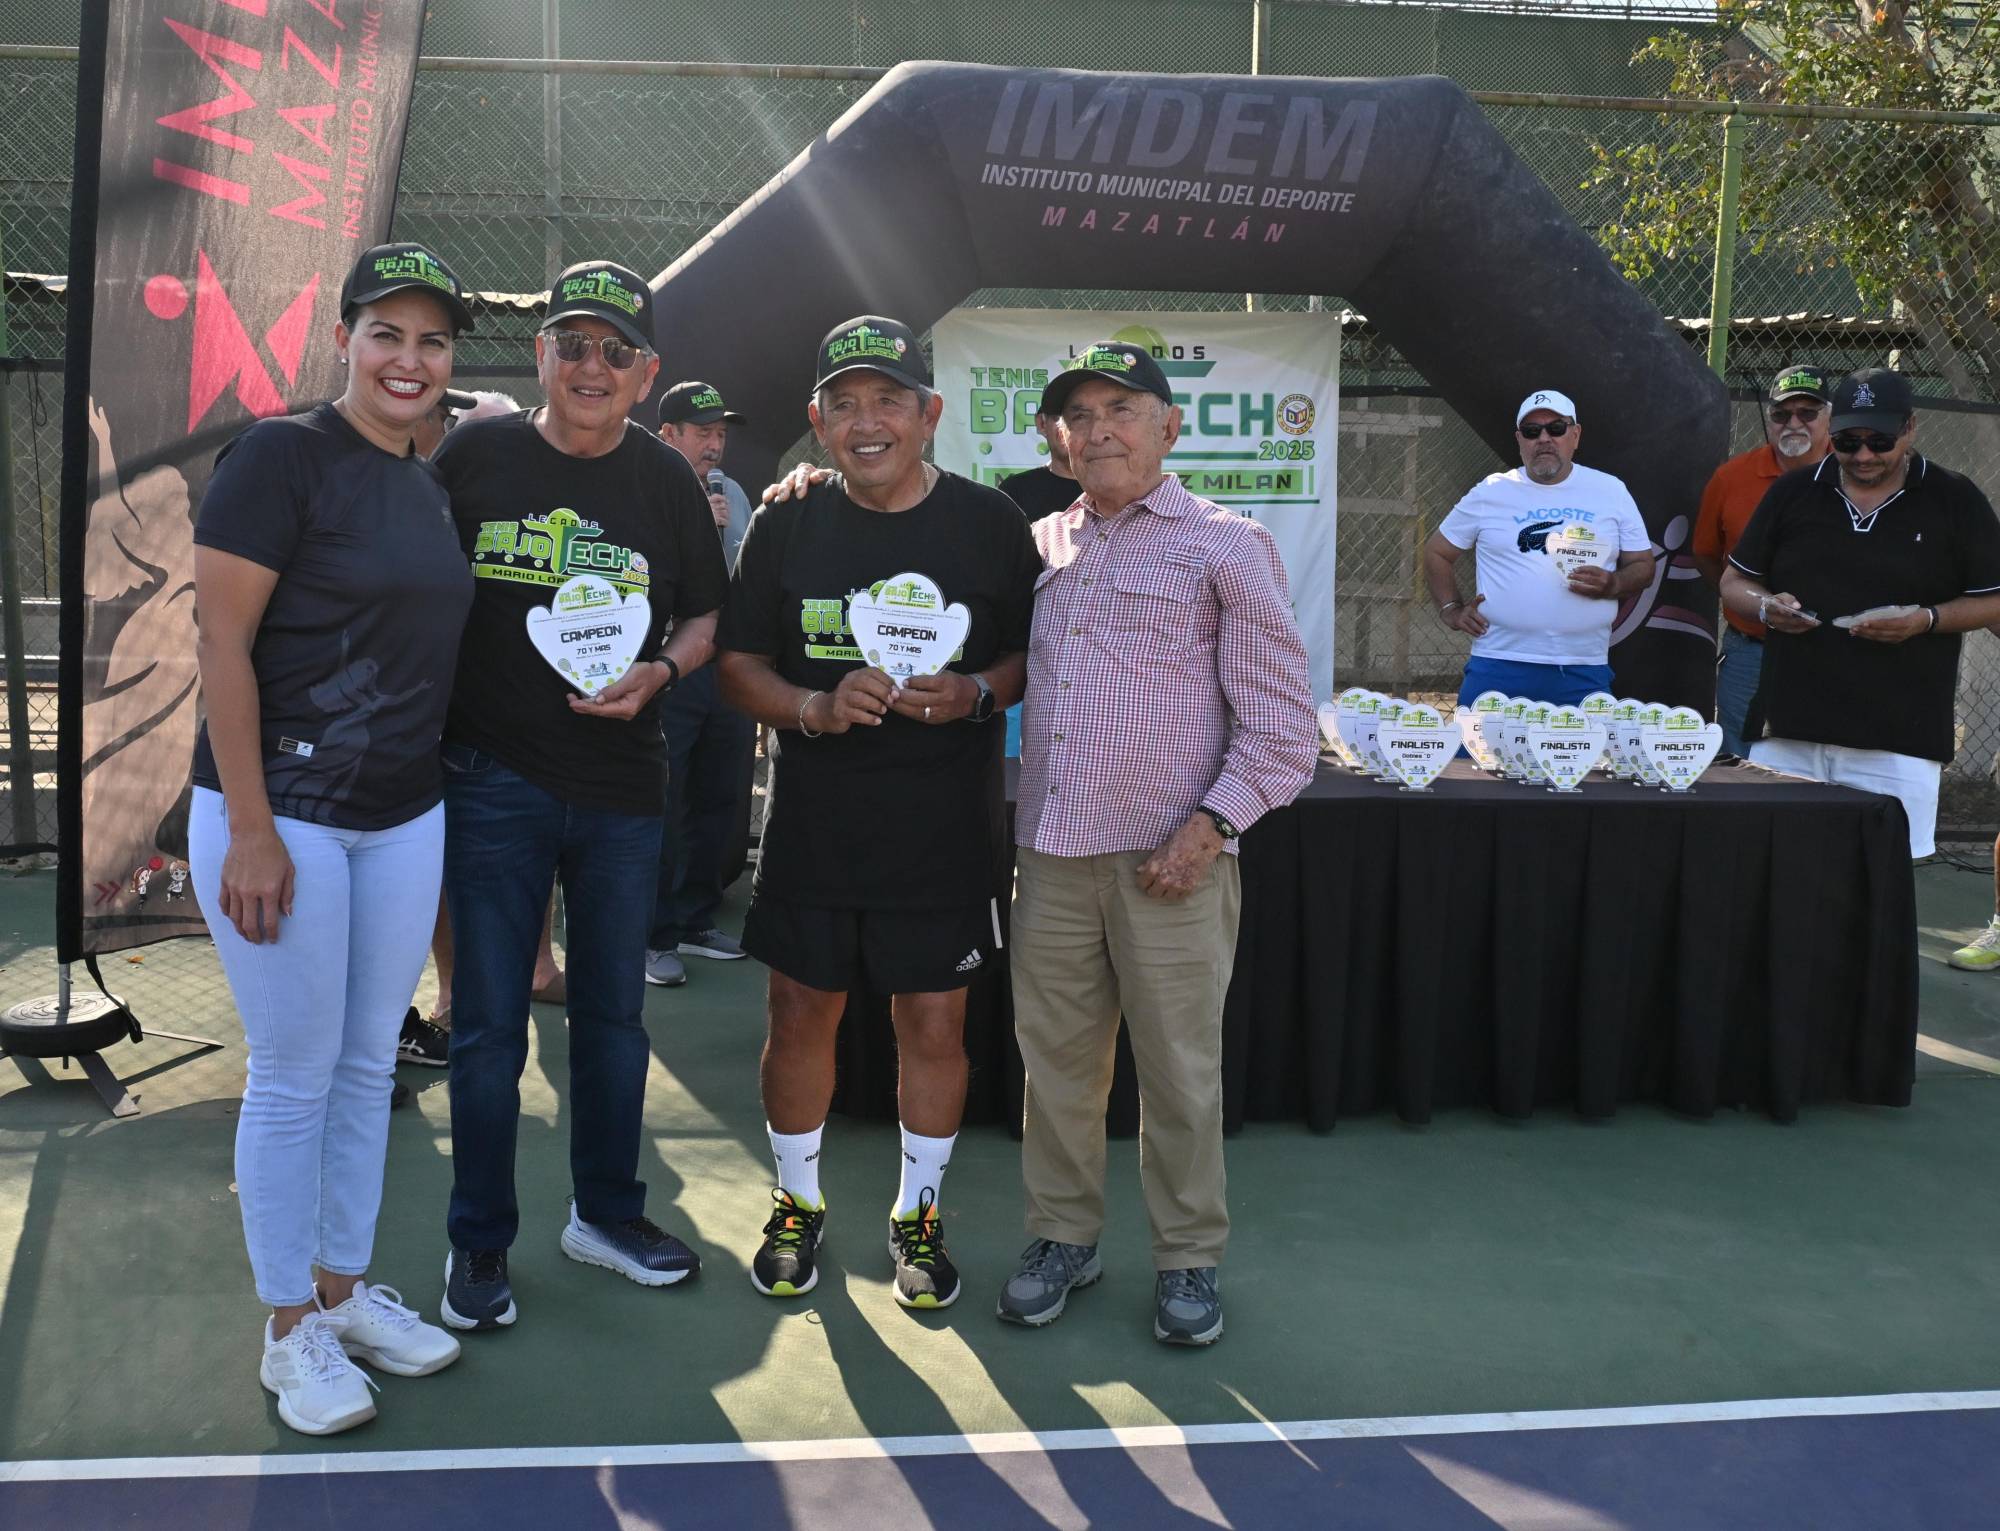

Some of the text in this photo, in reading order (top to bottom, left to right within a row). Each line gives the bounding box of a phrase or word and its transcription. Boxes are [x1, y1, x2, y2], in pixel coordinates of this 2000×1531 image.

[153, 0, 268, 207] IM
[984, 79, 1379, 184] IMDEM
[341, 98, 373, 240] INSTITUTO
[981, 163, 1356, 213] INSTITUTO MUNICIPAL DEL DEPORTE
[1041, 205, 1286, 243] MAZATLÁN
[970, 367, 1049, 389] TENIS
[970, 388, 1043, 435] BA
[1258, 439, 1316, 461] 2025
[1203, 474, 1292, 490] MILAN
[1512, 507, 1595, 524] LACOSTE
[474, 531, 552, 560] BAJO
[1556, 548, 1598, 558] FINALISTA
[491, 567, 535, 581] MARIO
[802, 610, 853, 635] BAJ
[560, 624, 623, 644] CAMPEON
[877, 624, 937, 642] CAMPEON
[576, 648, 588, 656] 70
[588, 646, 594, 654] Y
[594, 643, 612, 653] MAS
[826, 649, 863, 658] MARIO
[888, 643, 899, 652] 70
[906, 646, 922, 654] MAS
[1390, 740, 1445, 750] FINALISTA
[1540, 742, 1591, 751] FINALISTA
[1654, 743, 1705, 752] FINALISTA
